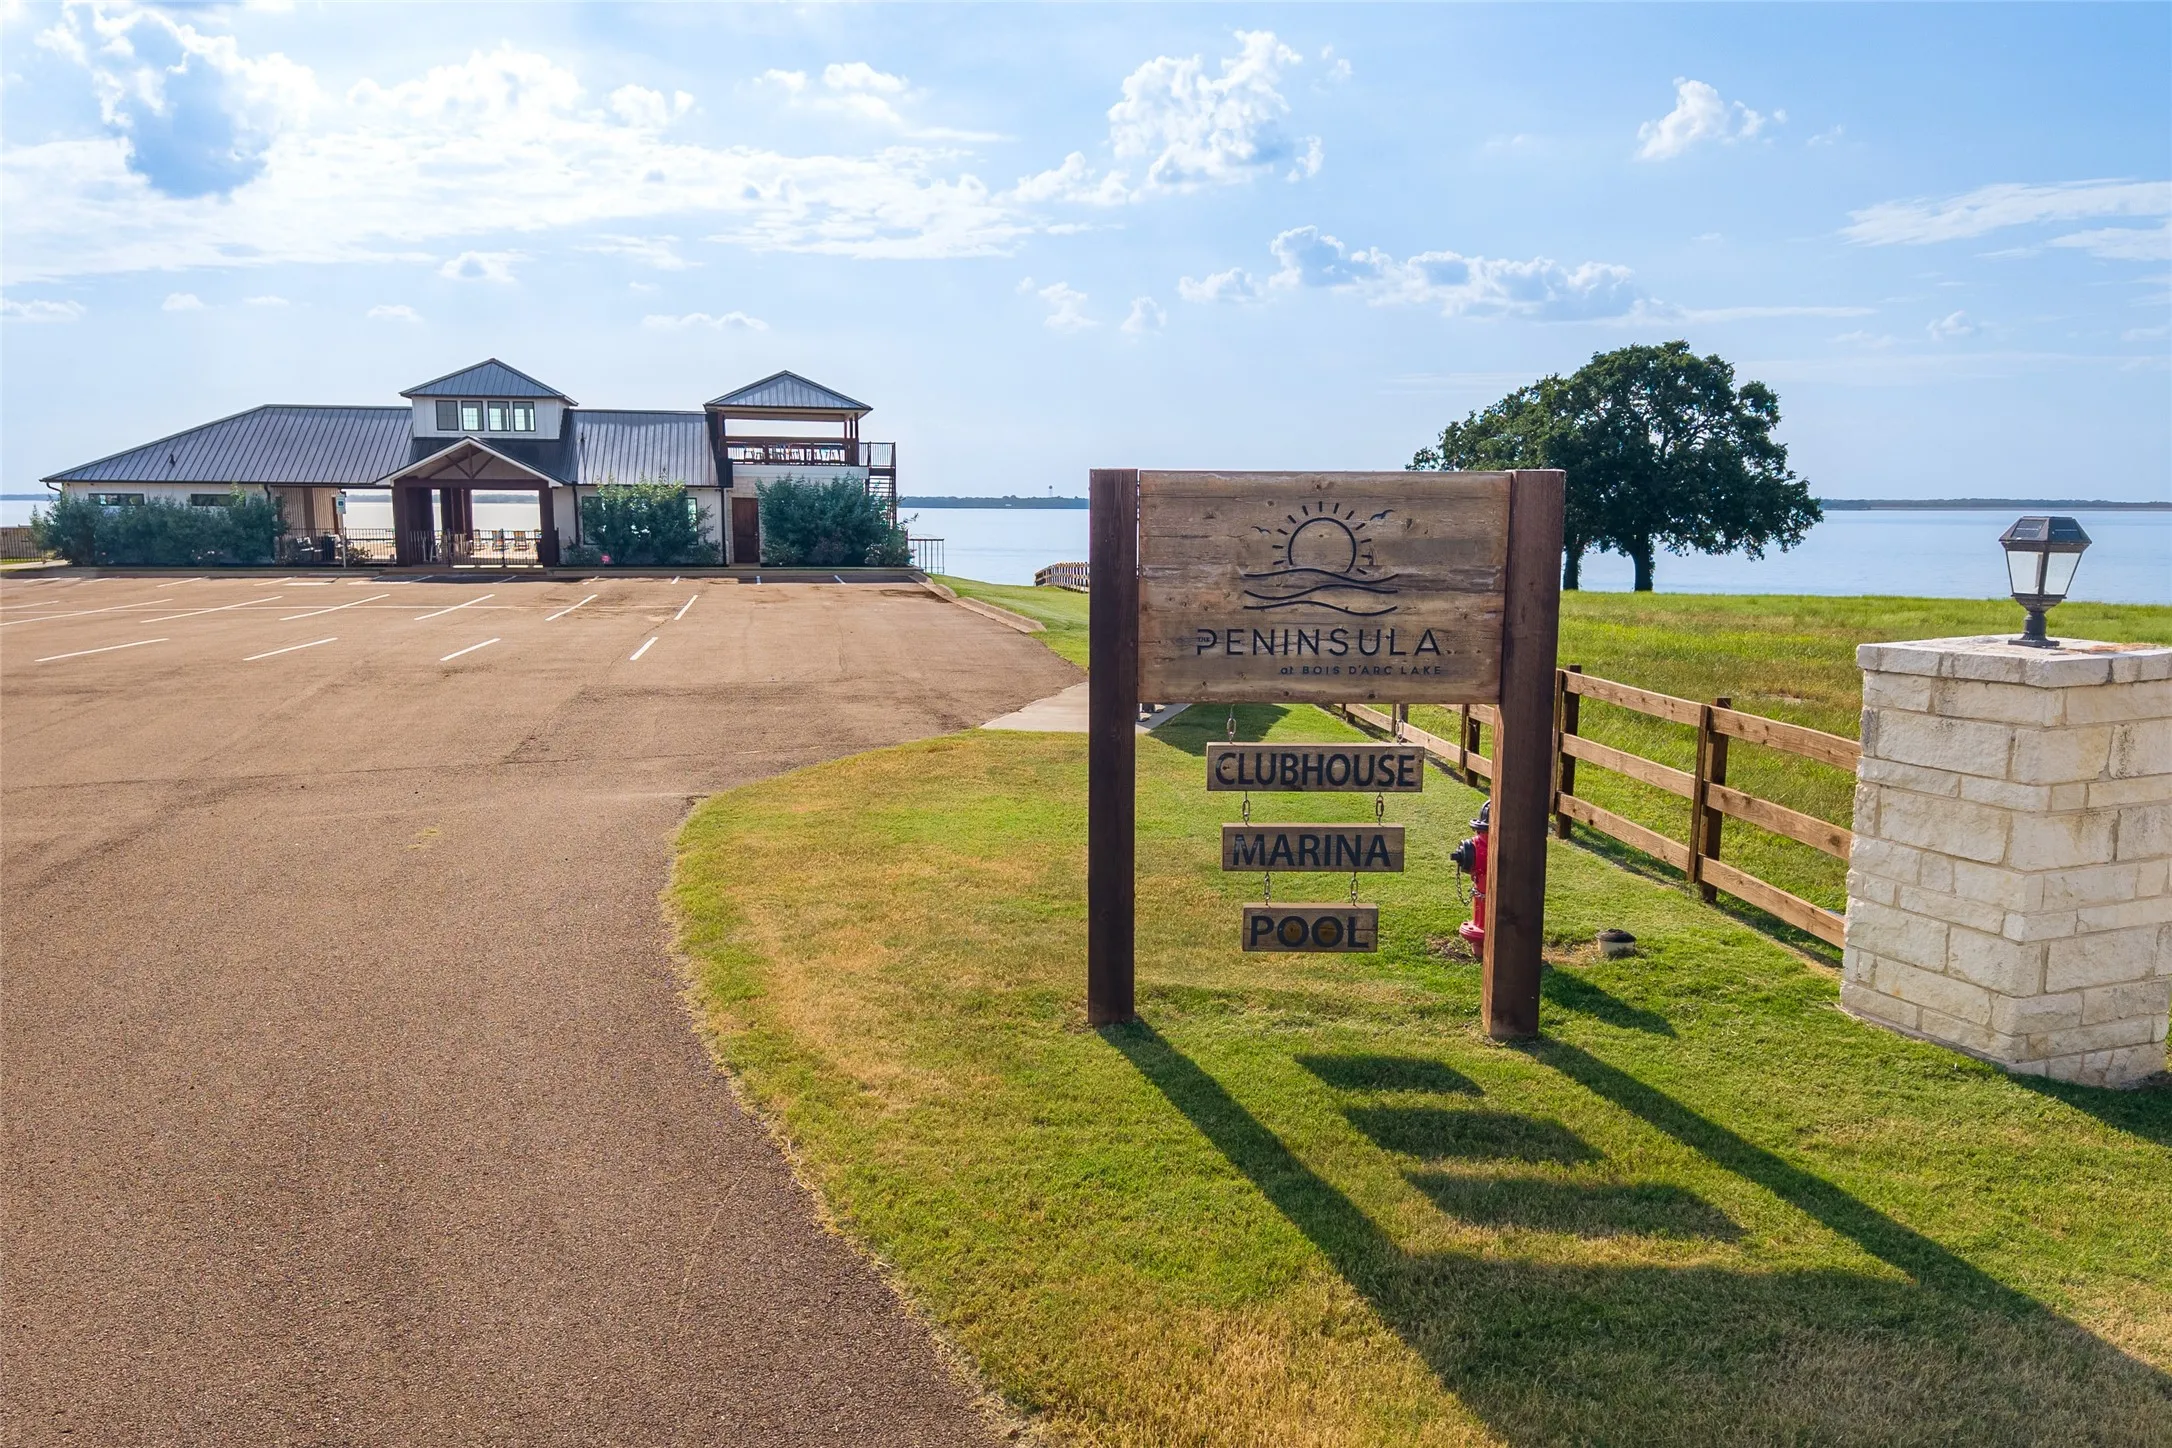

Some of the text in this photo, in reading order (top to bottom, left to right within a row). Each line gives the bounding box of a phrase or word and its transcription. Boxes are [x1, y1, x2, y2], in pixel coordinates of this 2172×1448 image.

[1196, 628, 1441, 656] PENINSULA
[1280, 665, 1442, 676] at BOIS D'ARC LAKE
[1215, 752, 1416, 787] CLUBHOUSE
[1232, 833, 1391, 867] MARINA
[1250, 915, 1370, 949] POOL
